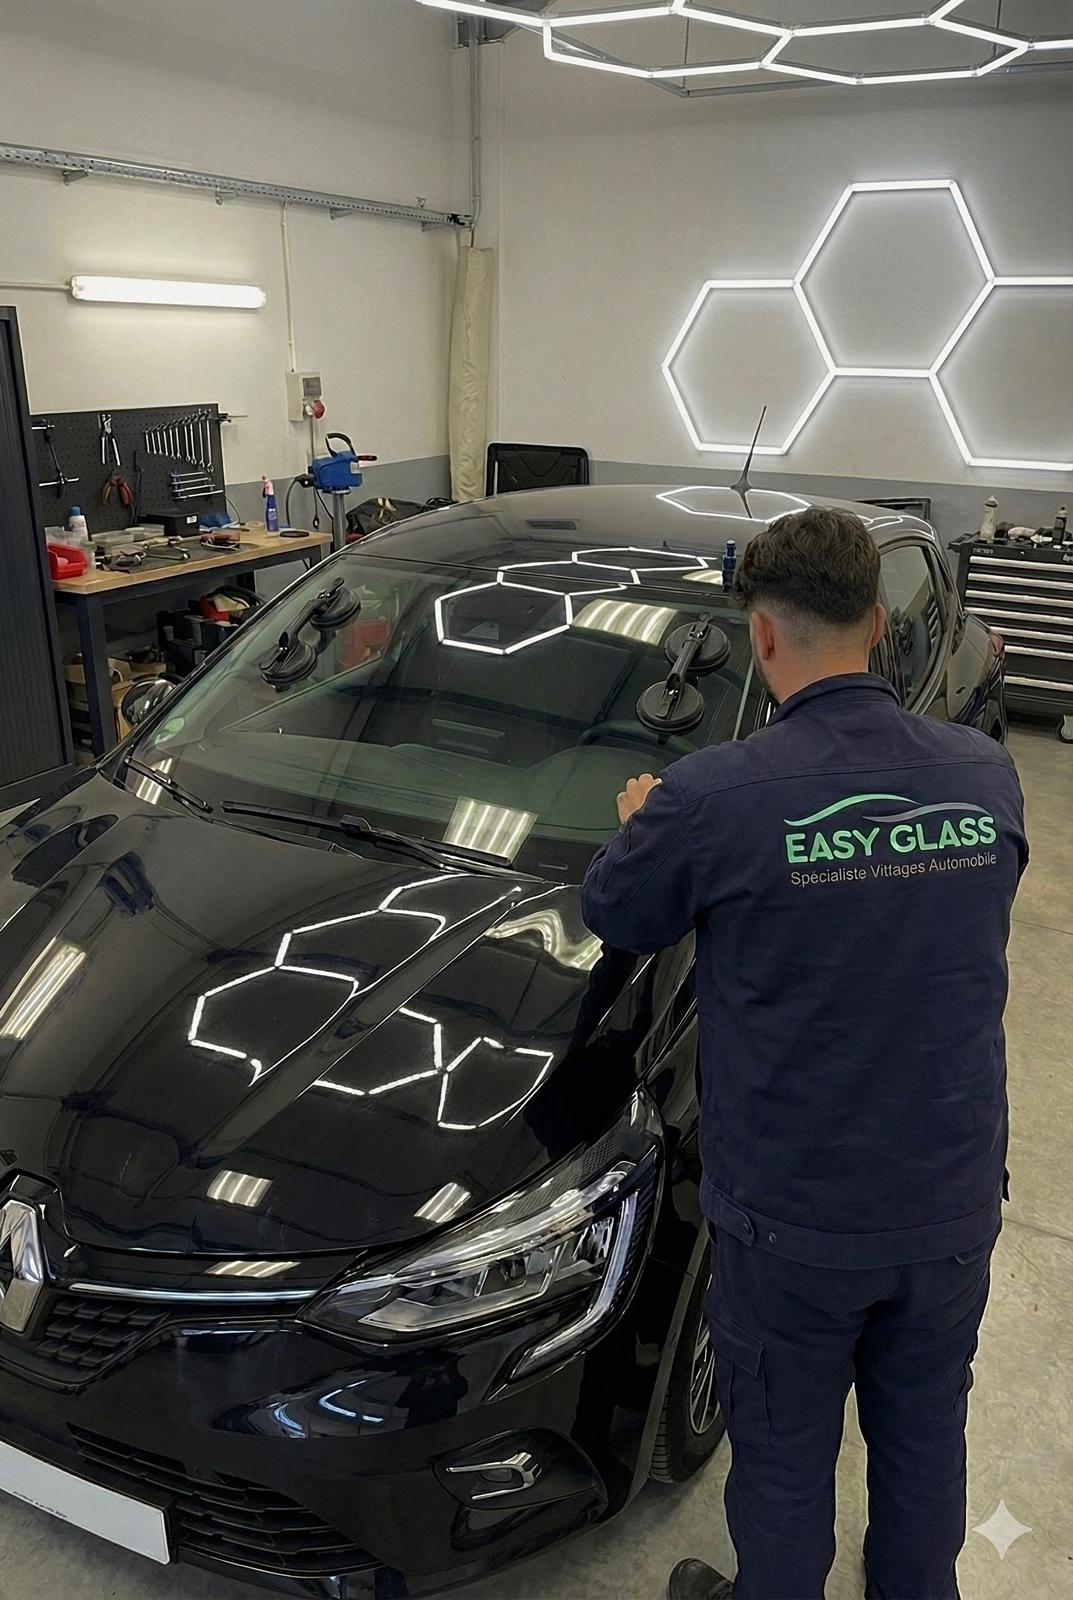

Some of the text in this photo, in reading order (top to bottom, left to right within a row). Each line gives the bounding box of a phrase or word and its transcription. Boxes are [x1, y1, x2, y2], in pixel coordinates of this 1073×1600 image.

[785, 816, 997, 864] EASY GLASS
[870, 862, 926, 878] Vittages
[928, 851, 997, 872] Automobile
